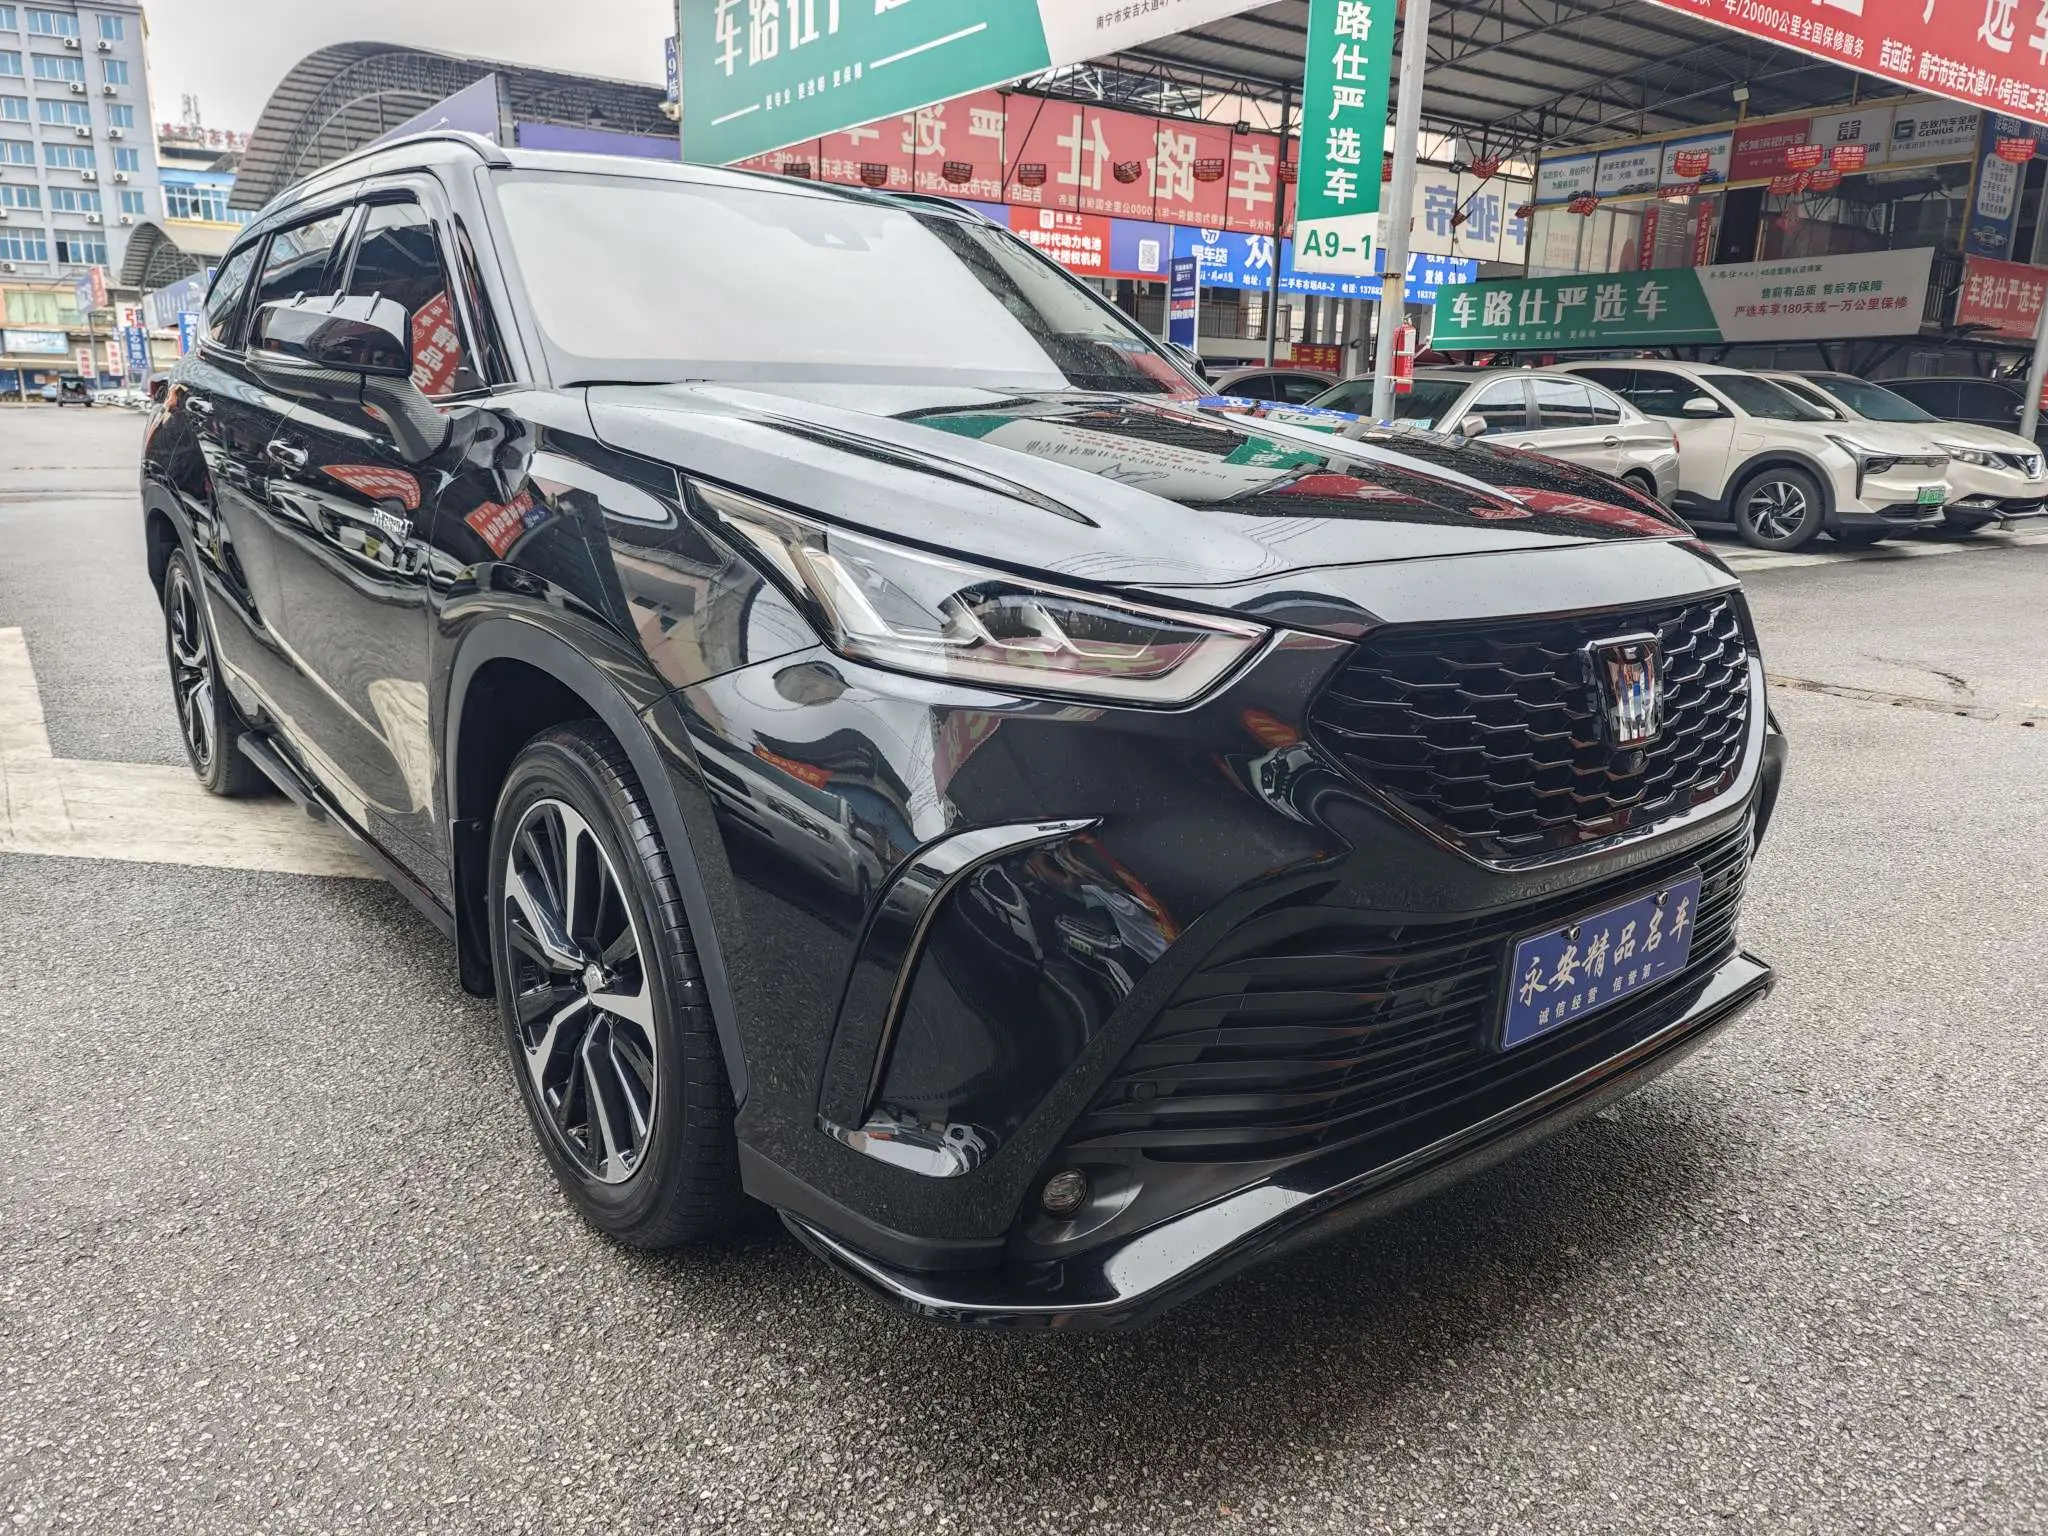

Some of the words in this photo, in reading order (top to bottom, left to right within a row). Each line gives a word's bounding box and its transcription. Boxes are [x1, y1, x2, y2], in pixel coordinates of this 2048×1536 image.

[666, 39, 680, 101] A9栋
[1323, 1, 1373, 204] 路仕严选车
[1919, 126, 1954, 137] GENIUS
[1302, 229, 1373, 261] A9-1
[1450, 281, 1669, 329] 车路仕严选车
[1734, 296, 1909, 317] 严选车享180天或一万公里保修
[1762, 284, 1817, 299] 售前有品质
[1823, 280, 1883, 295] 售后有保障
[1967, 273, 2043, 314] 车路仕严选车
[1518, 896, 1690, 1007] 永安精品名车
[1538, 986, 1598, 1025] 诚信经营
[1612, 961, 1665, 992] 信誉第一
